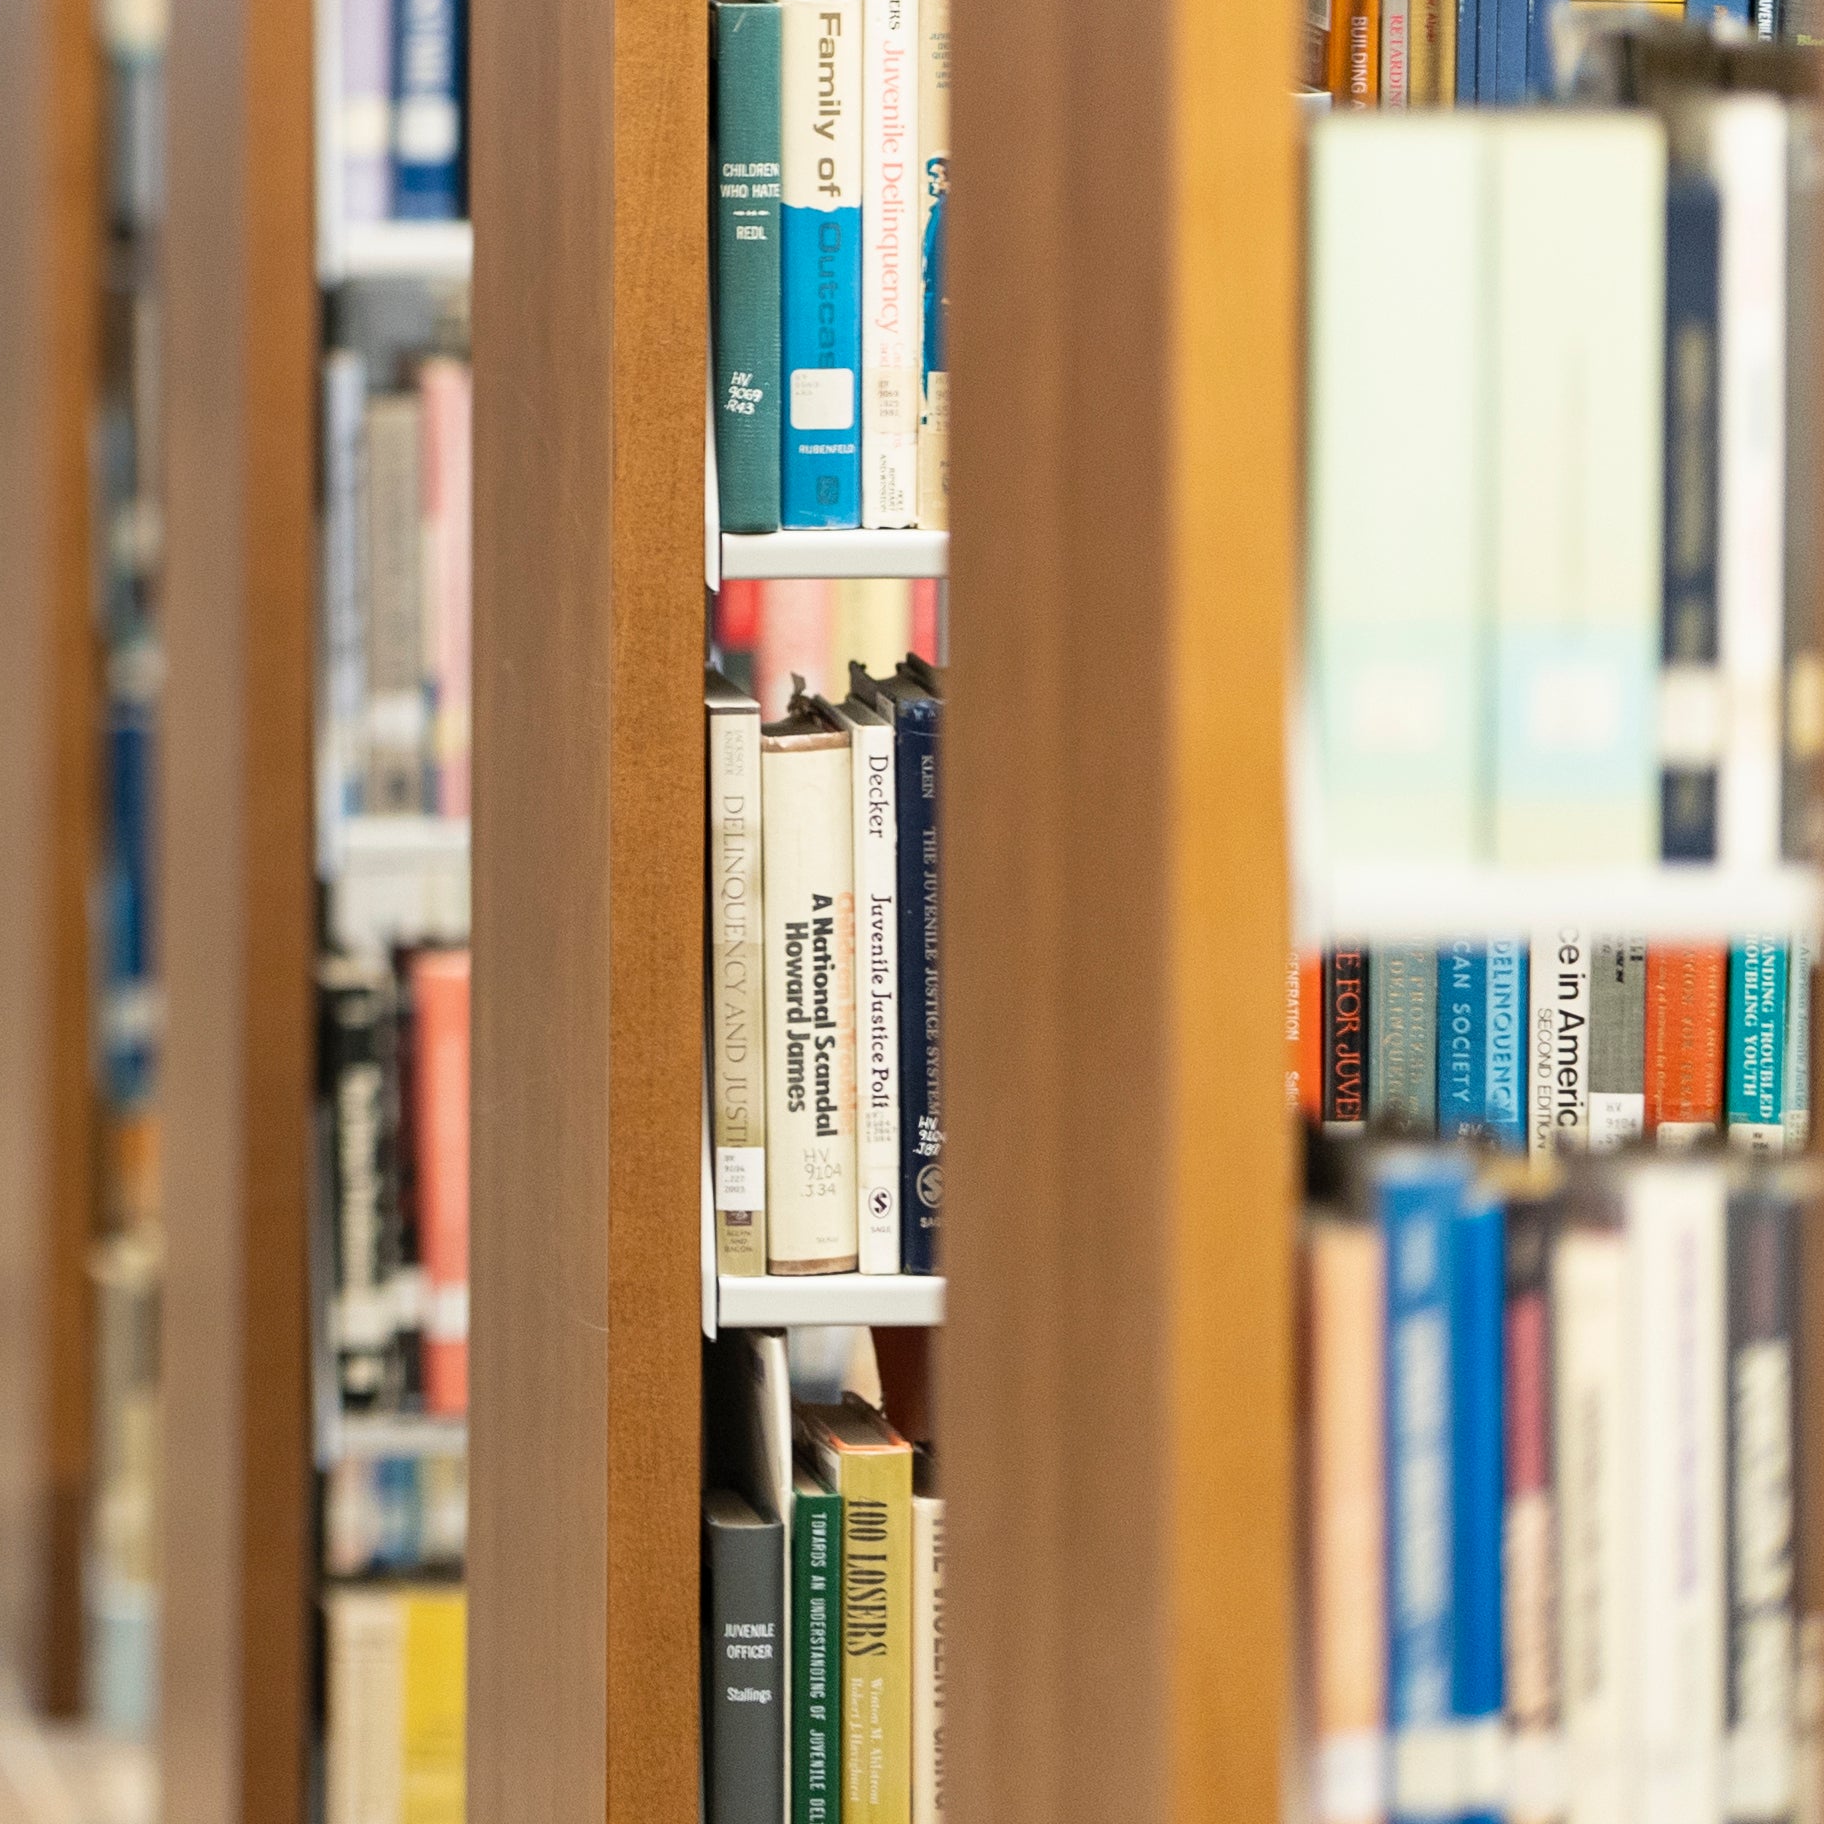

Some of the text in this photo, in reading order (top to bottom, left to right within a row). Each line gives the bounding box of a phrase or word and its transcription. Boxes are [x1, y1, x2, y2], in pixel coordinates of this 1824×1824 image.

[1352, 16, 1368, 94] BUILDING
[813, 12, 842, 198] Family of
[882, 40, 905, 153] Juvenile
[721, 184, 781, 198] WHO HATE
[723, 163, 780, 176] CHILDREN
[736, 226, 768, 240] REDL
[876, 161, 905, 335] Delinquency
[921, 754, 934, 799] KLEIN
[922, 827, 937, 865] THE
[722, 796, 747, 998] DELINQUENCY
[869, 755, 892, 1063] Decker Juvenile Justice
[924, 870, 939, 961] JUVENILE
[785, 922, 811, 1114] Howard James
[812, 894, 838, 1137] A National Scandal
[924, 967, 939, 1041] JUSTICE
[1335, 978, 1361, 1037] FOR
[1557, 973, 1586, 1000] in
[724, 1002, 747, 1063] AND
[1452, 1003, 1471, 1103] SOCIETY
[1537, 1007, 1553, 1078] SECOND
[1743, 1035, 1758, 1096] YOUTH
[1760, 1021, 1775, 1119] TROUBLED
[723, 1072, 748, 1147] JUSTI
[803, 1149, 831, 1163] HV
[805, 1164, 842, 1180] 9104
[724, 1623, 775, 1638] JUVENILE
[847, 1554, 887, 1656] LOSERS
[726, 1644, 773, 1659] OFFICER
[809, 1512, 827, 1791] TOWARDS AN UNDERSTANDING OF JUVENILE
[727, 1687, 772, 1704] Stallings
